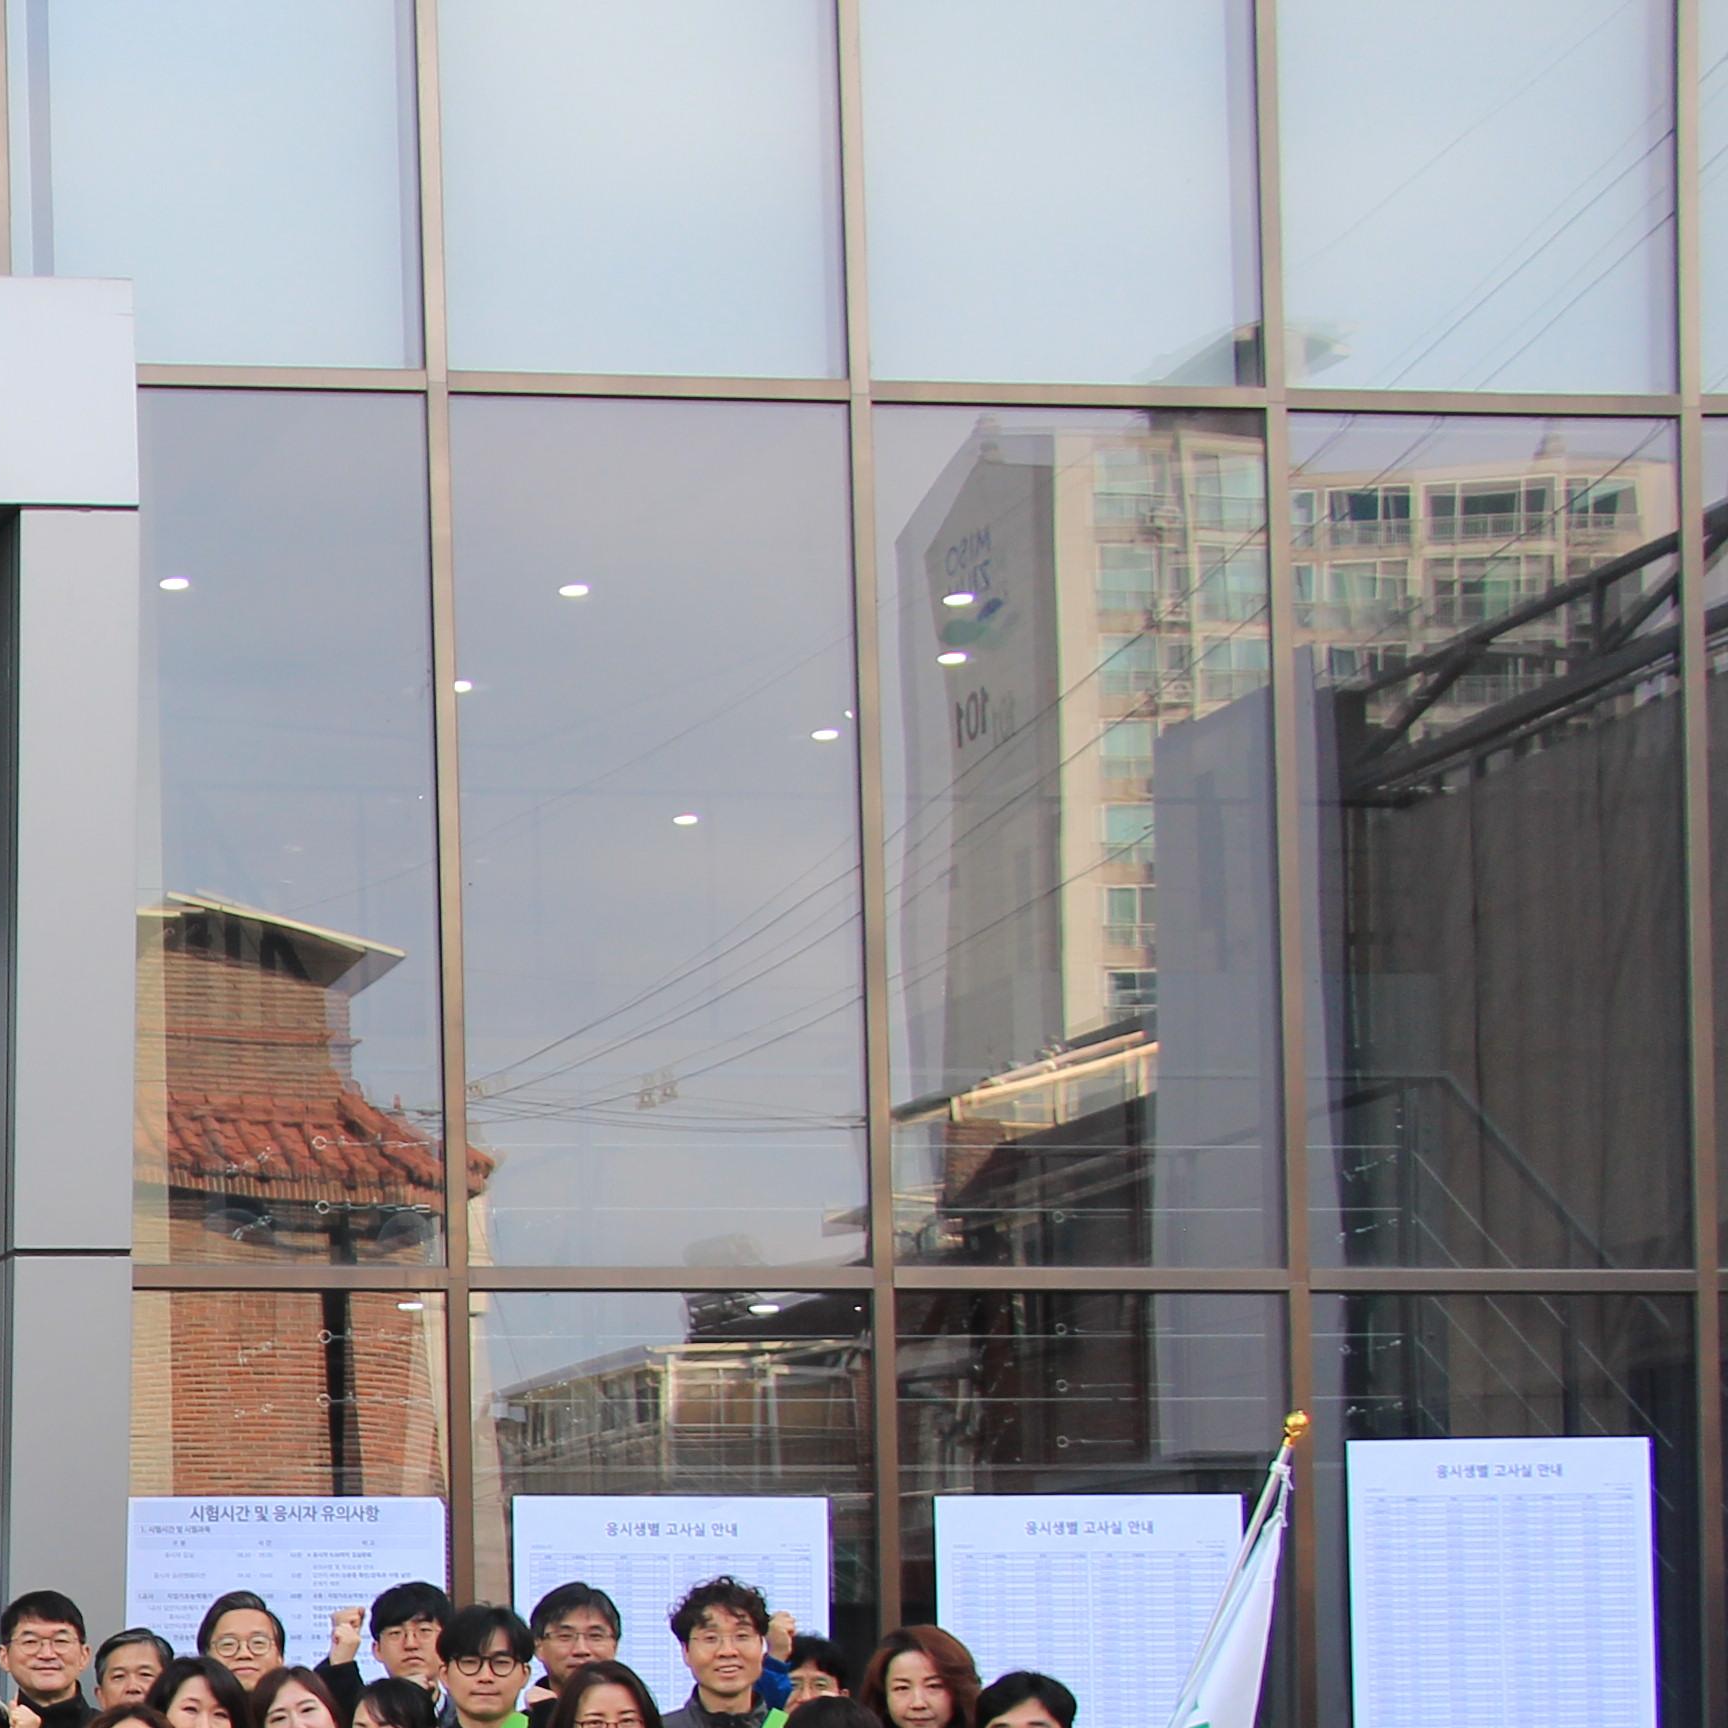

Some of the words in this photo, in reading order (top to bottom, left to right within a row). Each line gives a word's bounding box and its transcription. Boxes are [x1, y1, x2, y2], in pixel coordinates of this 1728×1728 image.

[190, 1505, 251, 1522] 시험시간
[254, 1505, 270, 1522] 및
[272, 1505, 318, 1522] 응시자
[321, 1504, 380, 1522] 유의사항
[666, 1522, 706, 1537] 고사실
[711, 1521, 739, 1537] 안내
[1083, 1521, 1123, 1535] 고사실
[1128, 1520, 1155, 1535] 안내
